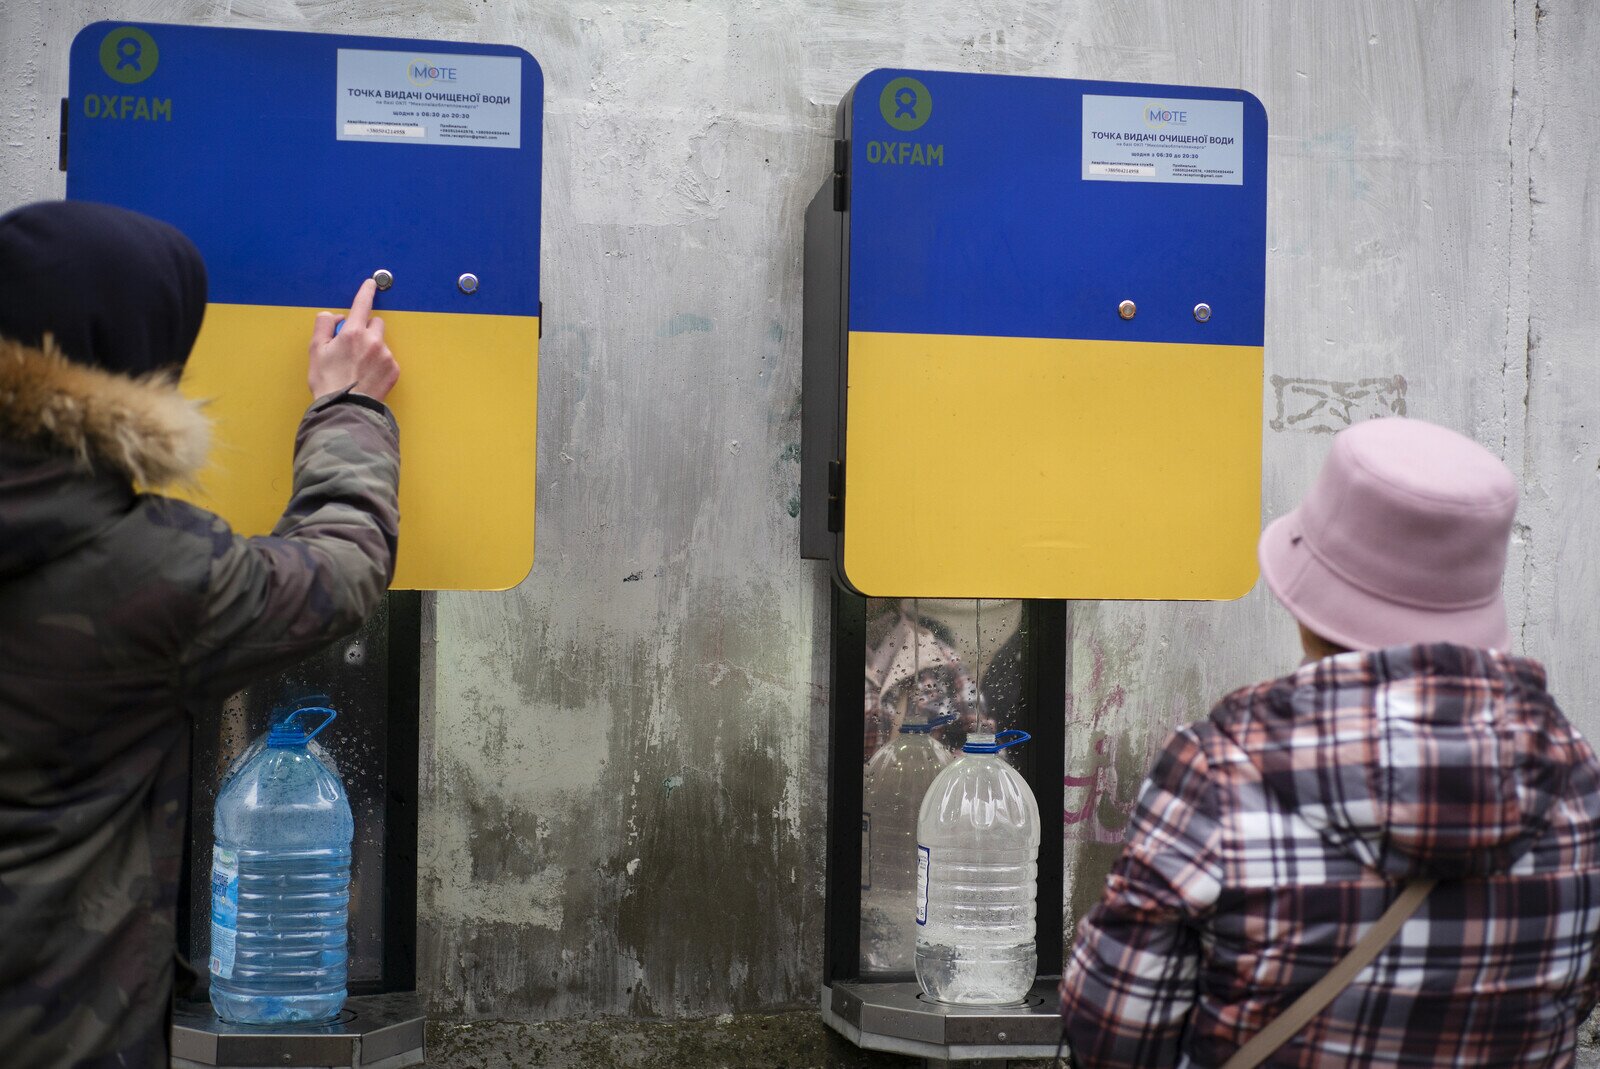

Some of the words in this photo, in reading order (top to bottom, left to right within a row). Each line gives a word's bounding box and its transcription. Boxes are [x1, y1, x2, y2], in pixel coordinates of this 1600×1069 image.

[348, 88, 382, 98] ТОЧКА
[384, 90, 422, 101] ВИДАЧІ
[425, 92, 481, 103] ОЧИЩЕНОЇ
[482, 95, 511, 105] ВОДИ
[84, 94, 172, 121] OXFAM
[1092, 131, 1122, 140] ТОЧКА
[1124, 132, 1157, 142] ВИДАЧІ
[1159, 134, 1207, 145] ОЧИЩЕНОЇ
[1209, 136, 1234, 146] ВОДИ
[867, 141, 944, 166] OXFAM
